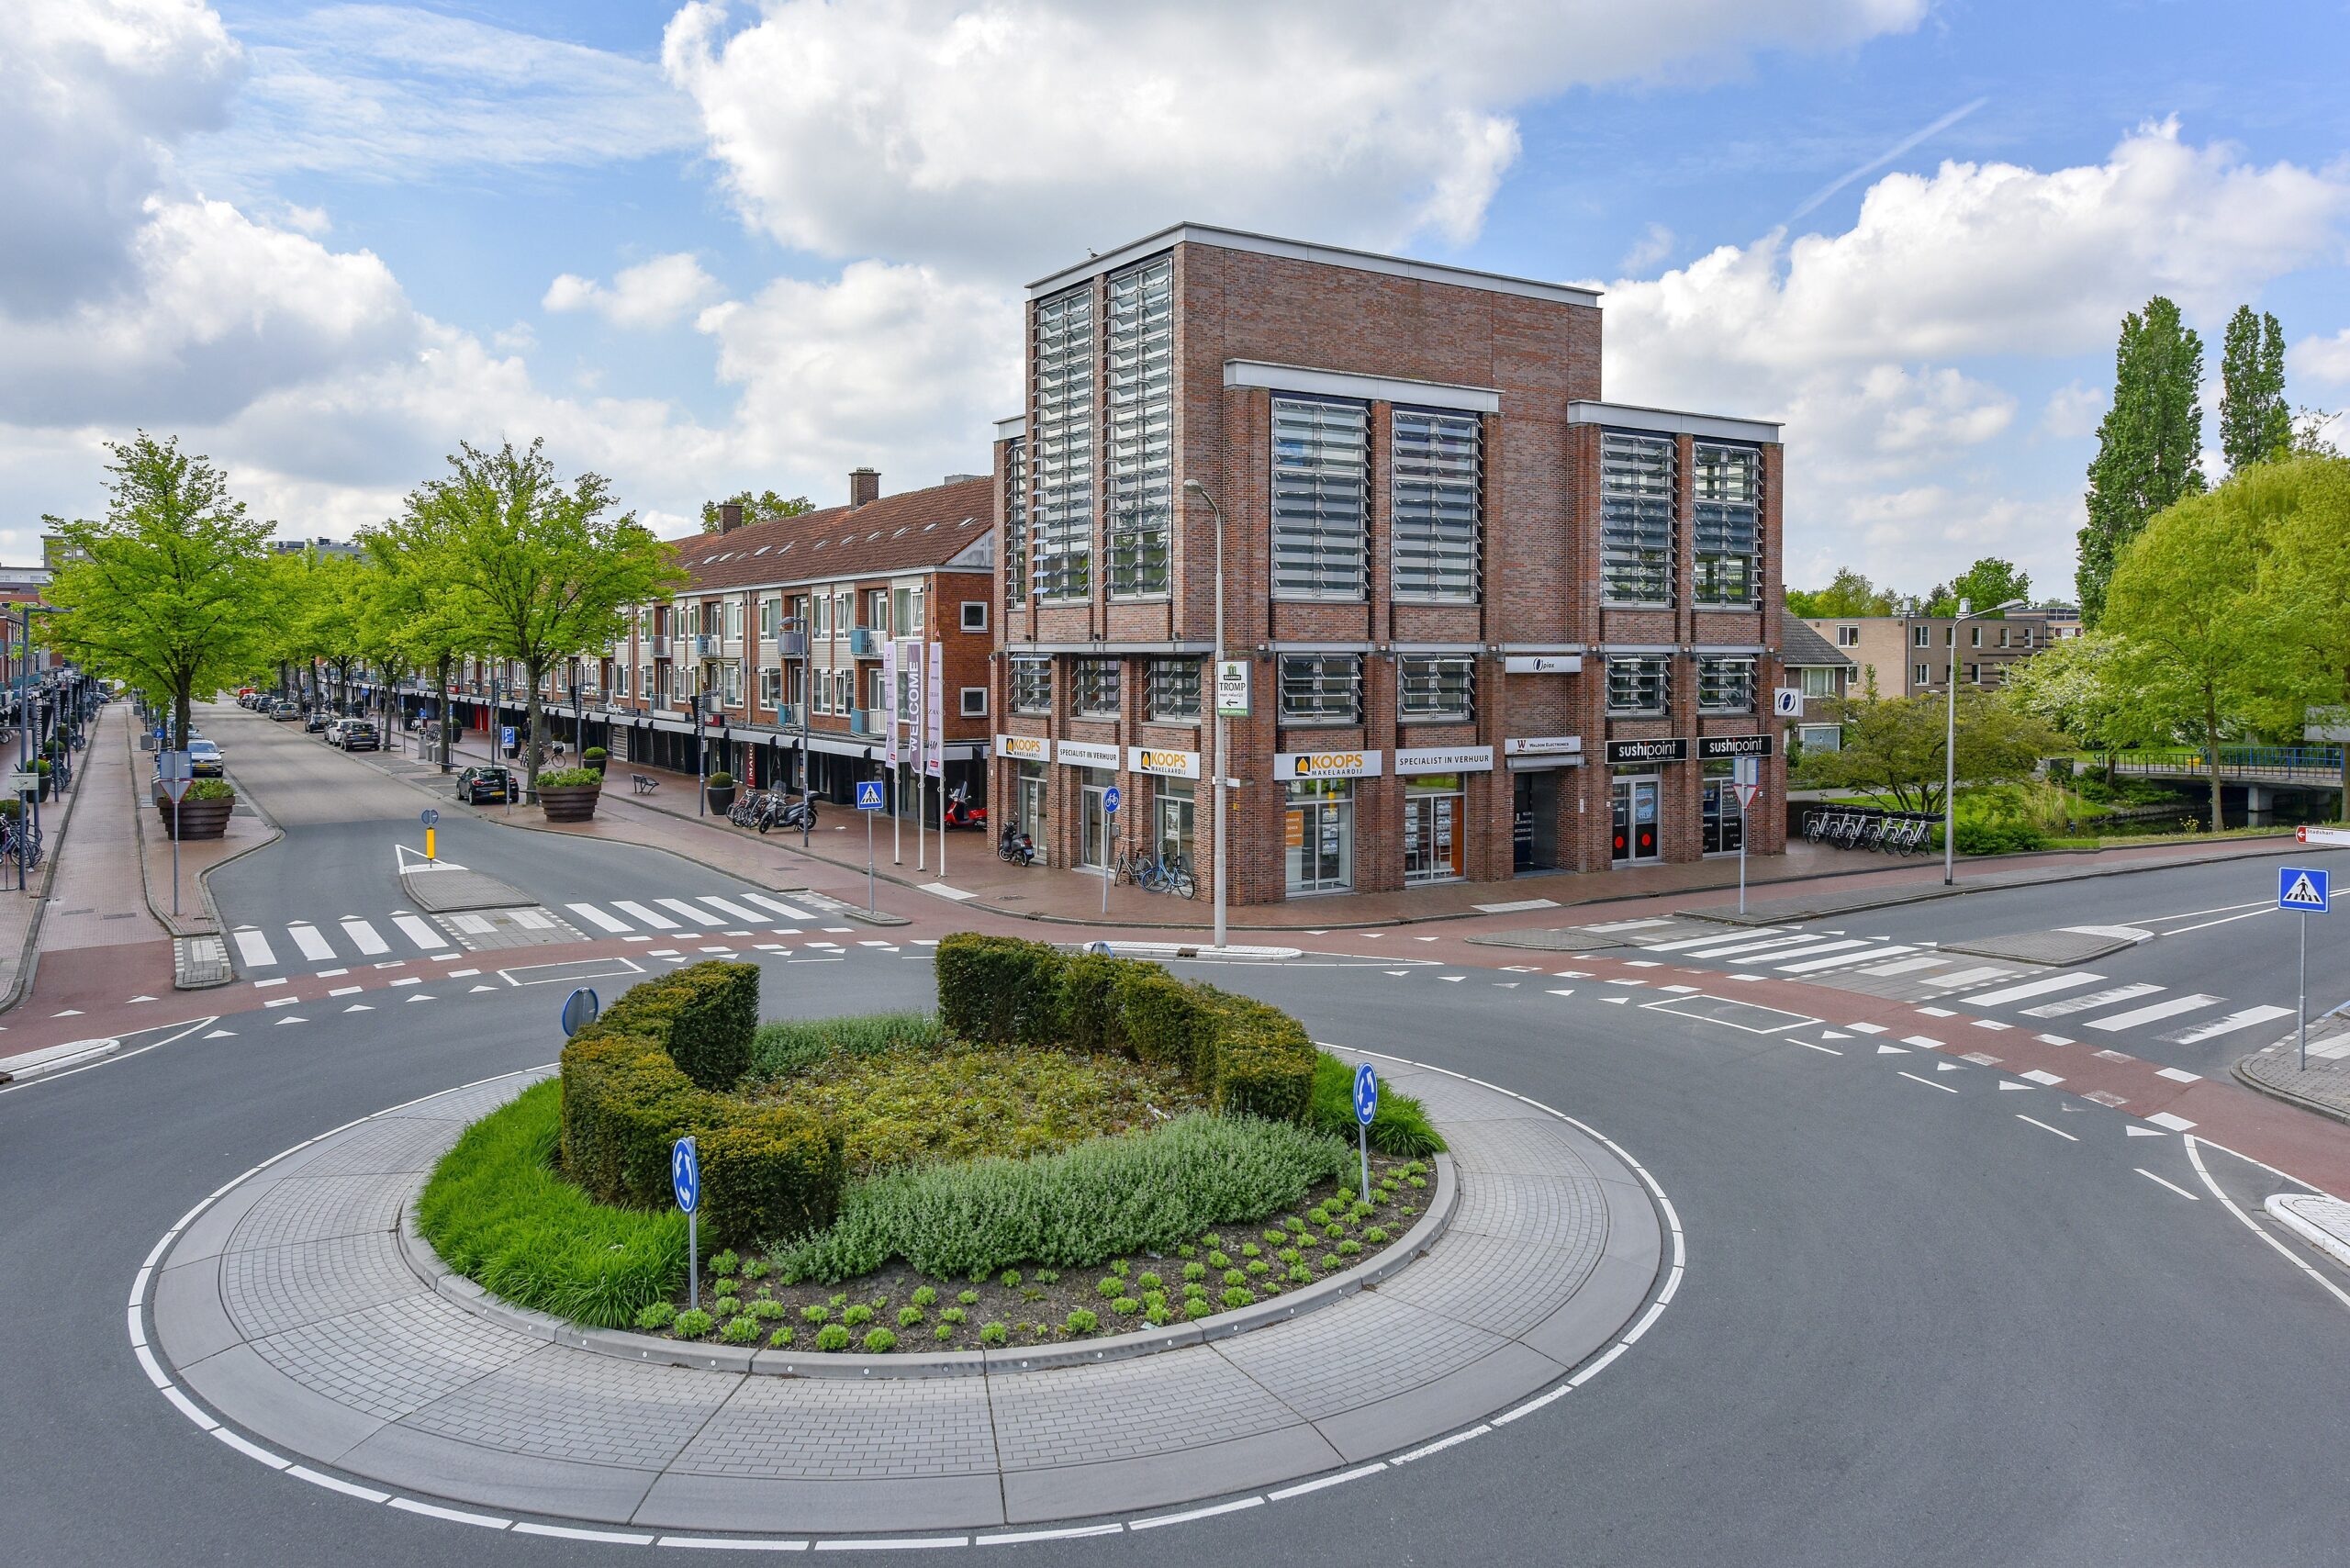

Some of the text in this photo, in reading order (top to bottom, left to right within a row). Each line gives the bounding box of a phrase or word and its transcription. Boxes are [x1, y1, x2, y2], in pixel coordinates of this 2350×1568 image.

[1219, 682, 1246, 691] TROMP
[909, 661, 919, 752] WELCOME
[1014, 738, 1041, 753] KOOPS
[1618, 741, 1676, 761] sushipoint
[1709, 737, 1762, 756] sushipoint
[1059, 748, 1086, 758] SPECIALIST
[1093, 752, 1117, 762] VERHUUR
[1151, 752, 1186, 768] KOOPS
[1311, 754, 1363, 768] KOOPS
[1399, 756, 1442, 766] SPECIALIST
[1454, 755, 1489, 763] VERHUUR
[1151, 766, 1186, 776] MAKELAARDIJ
